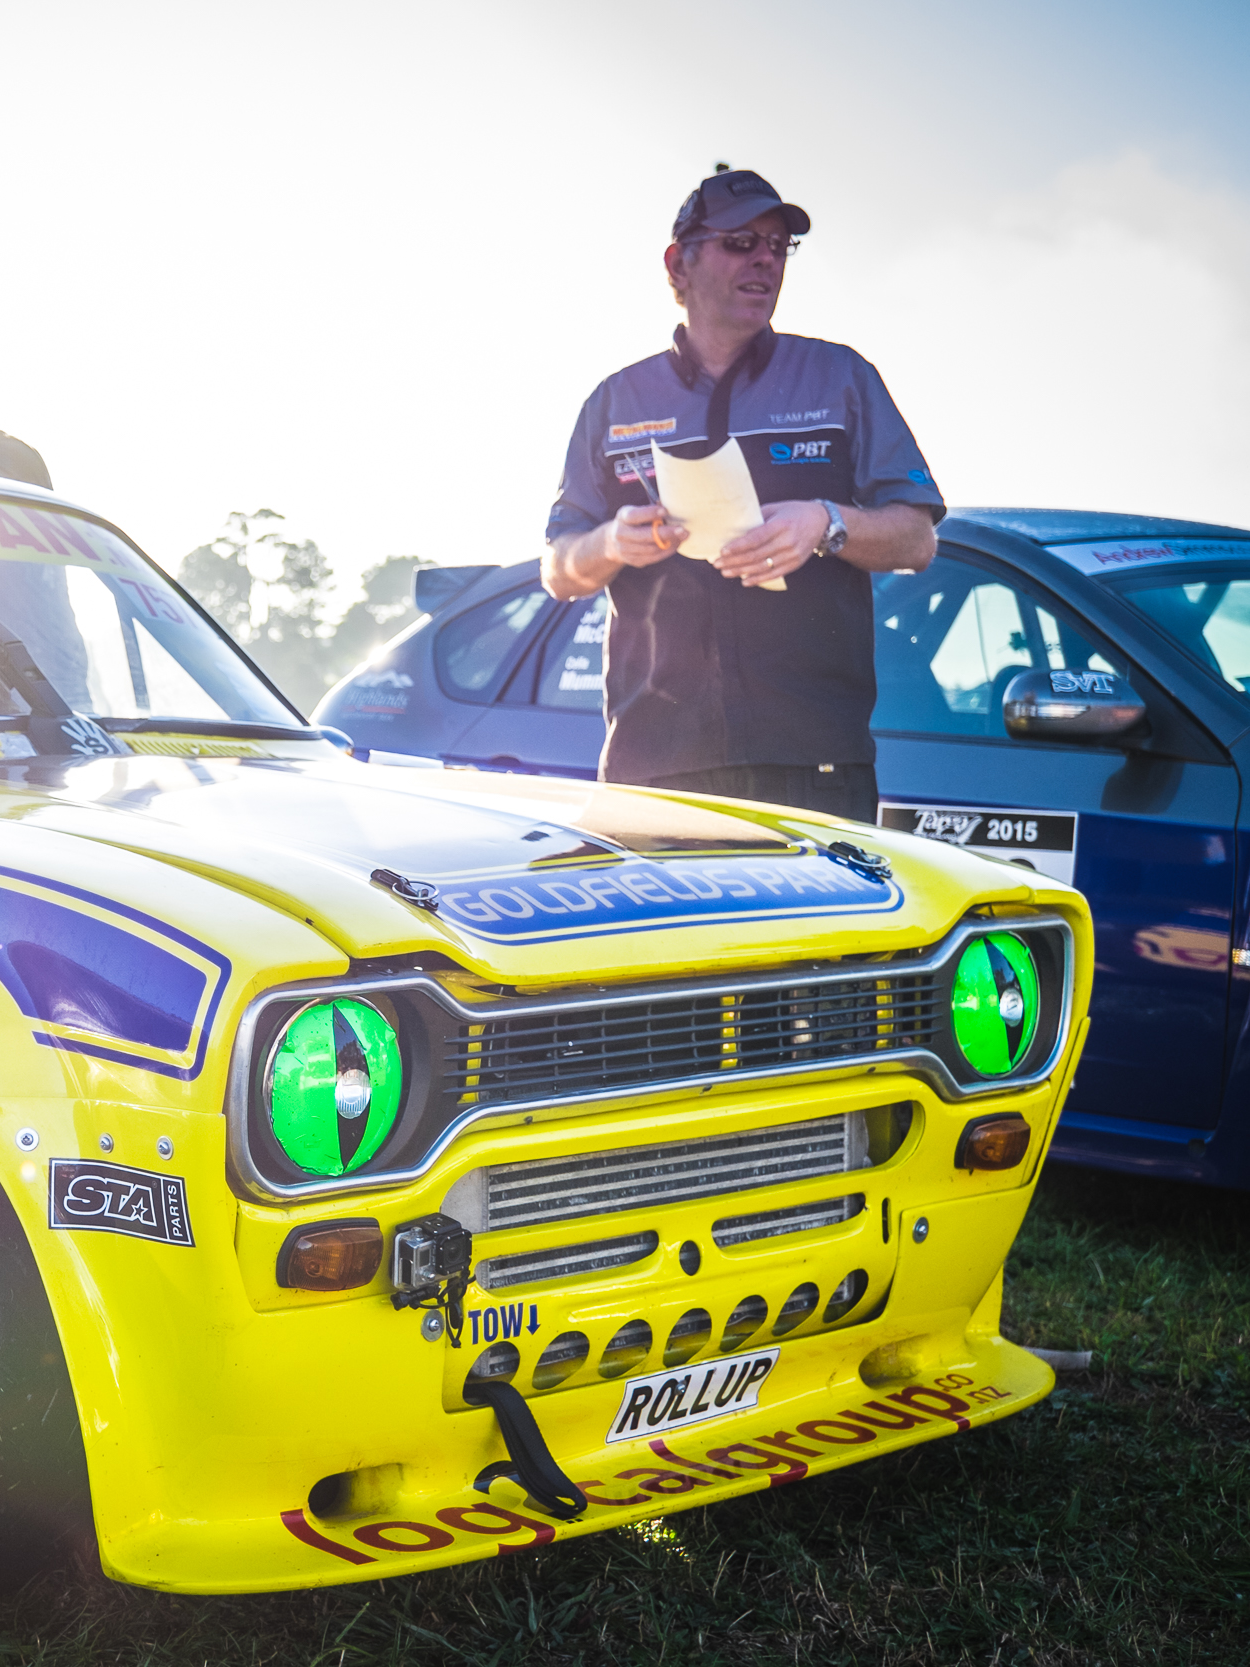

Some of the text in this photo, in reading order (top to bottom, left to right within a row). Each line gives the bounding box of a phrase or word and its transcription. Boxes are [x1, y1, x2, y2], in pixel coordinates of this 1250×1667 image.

[769, 408, 831, 425] TEAM PBT
[792, 440, 832, 458] PBT
[986, 818, 1038, 842] 2015
[444, 865, 754, 923] GOLDFIELDS
[63, 1174, 158, 1227] STA
[167, 1184, 183, 1238] PARTS
[468, 1303, 524, 1345] TOW
